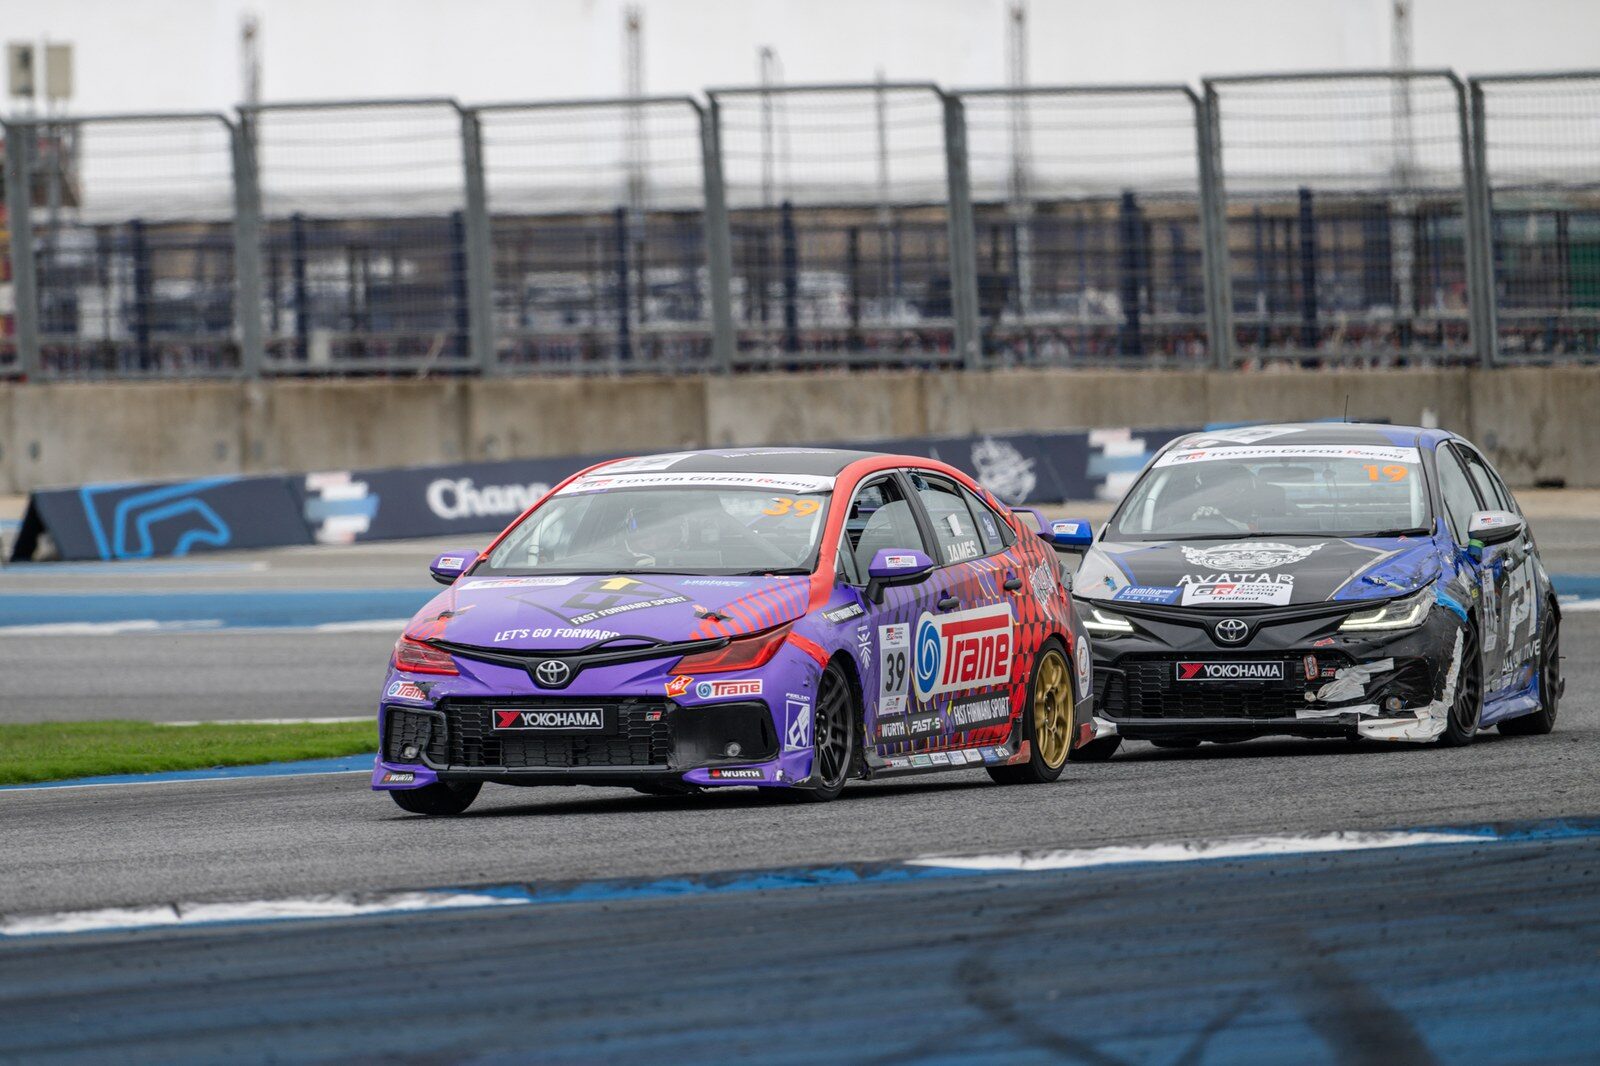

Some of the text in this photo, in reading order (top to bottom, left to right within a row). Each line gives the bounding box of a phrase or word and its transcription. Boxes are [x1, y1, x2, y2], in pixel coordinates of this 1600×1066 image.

[1210, 449, 1276, 457] TOYOTA
[1345, 449, 1404, 459] Racing
[1363, 464, 1408, 482] 19
[615, 476, 684, 485] TOYOTA
[756, 477, 817, 489] Racing
[761, 497, 820, 518] 39
[946, 540, 979, 562] JAMES
[1176, 572, 1295, 587] AVATAR
[1192, 584, 1237, 597] GR
[570, 595, 687, 626] FAST FORWARD SPORT
[493, 628, 621, 642] LET'S GO FORWARD
[941, 613, 1010, 686] Trane
[885, 651, 906, 692] 39
[1203, 664, 1281, 678] YOKOHAMA
[712, 680, 761, 696] Trane
[520, 712, 600, 726] YOKOHAMA
[953, 704, 968, 726] FAST
[991, 696, 1010, 718] SPORT
